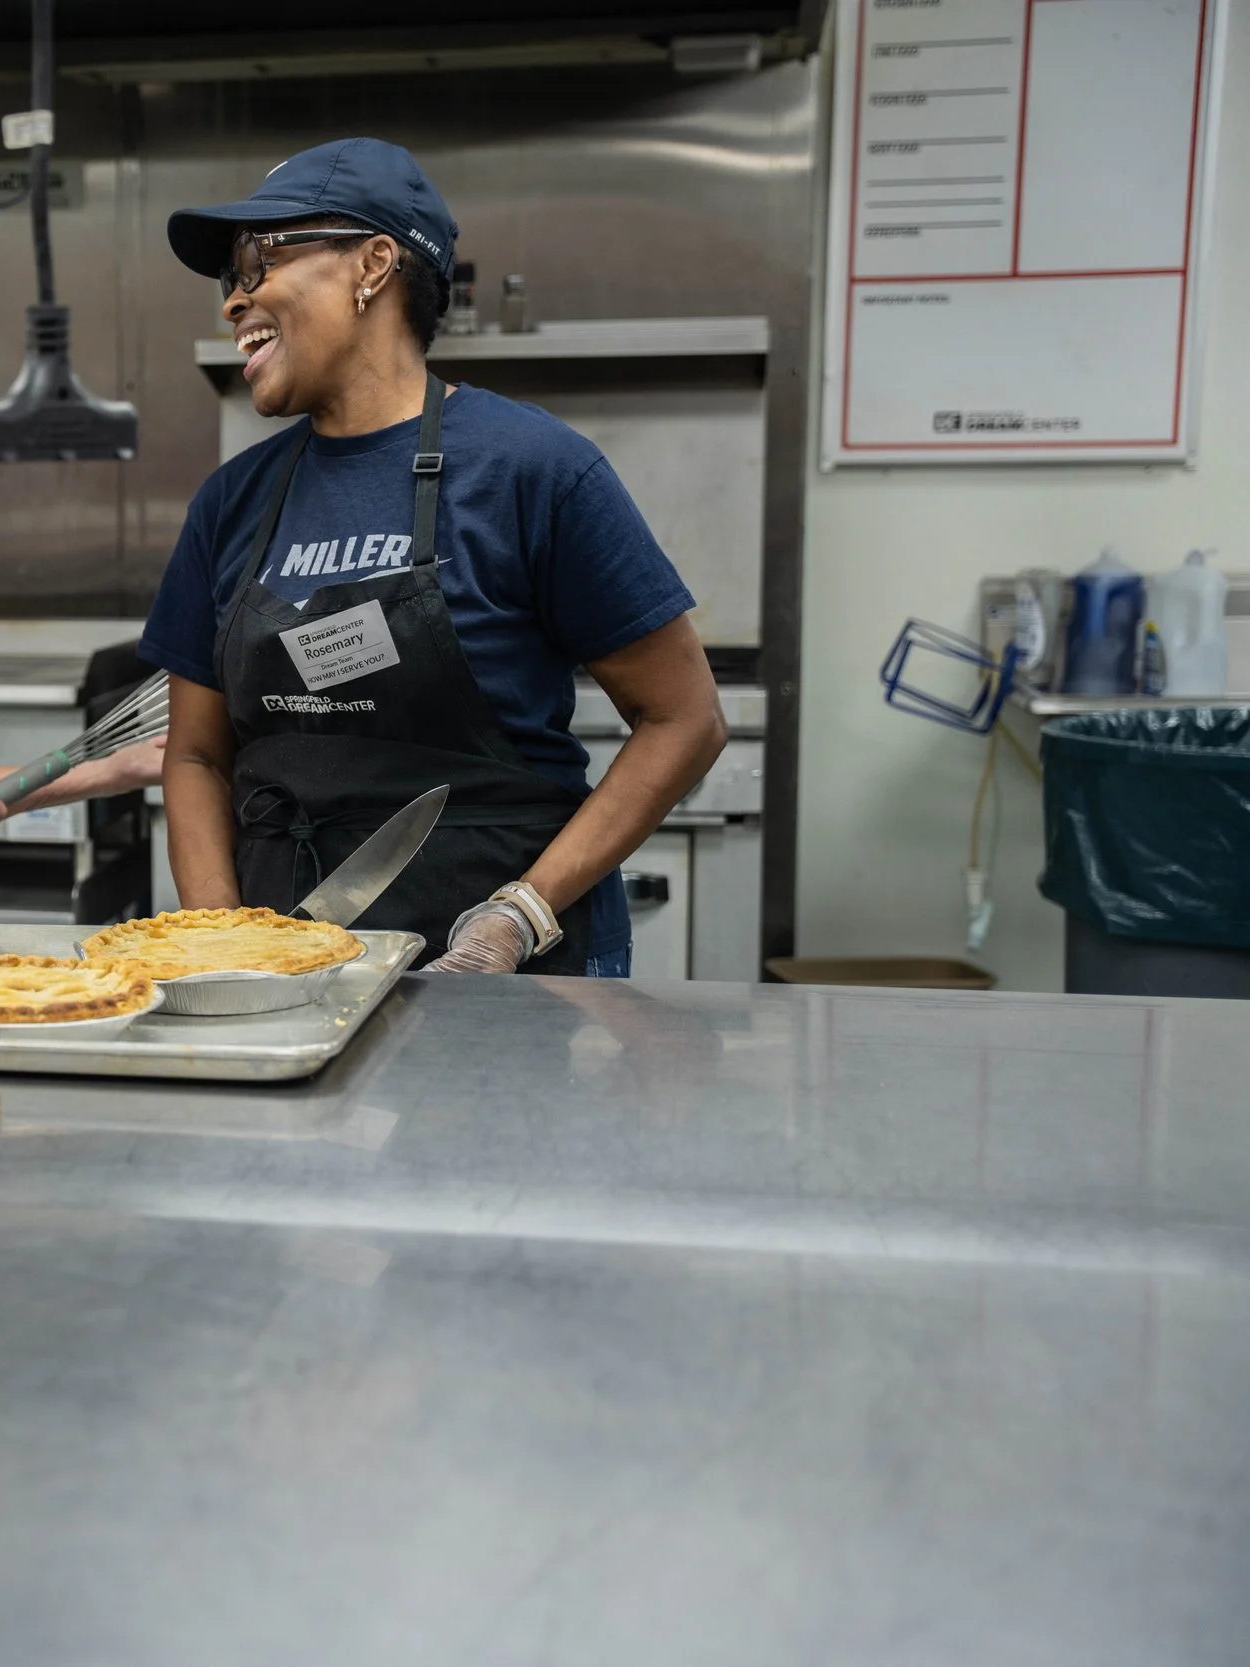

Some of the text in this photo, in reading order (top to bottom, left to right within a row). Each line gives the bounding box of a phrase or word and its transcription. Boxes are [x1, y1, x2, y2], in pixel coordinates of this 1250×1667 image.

[409, 228, 440, 255] DRI-FIT
[280, 534, 412, 576] MILLER
[312, 619, 364, 643] DREAMCENTER
[304, 633, 363, 660] Rosemary
[307, 675, 322, 683] HOW
[323, 671, 337, 680] MAY
[341, 662, 364, 675] SERVE
[364, 653, 385, 666] YOU?
[321, 656, 353, 670] Dream Team
[284, 695, 330, 704] SPRINGFIELD
[287, 700, 376, 714] DREAMCENTER
